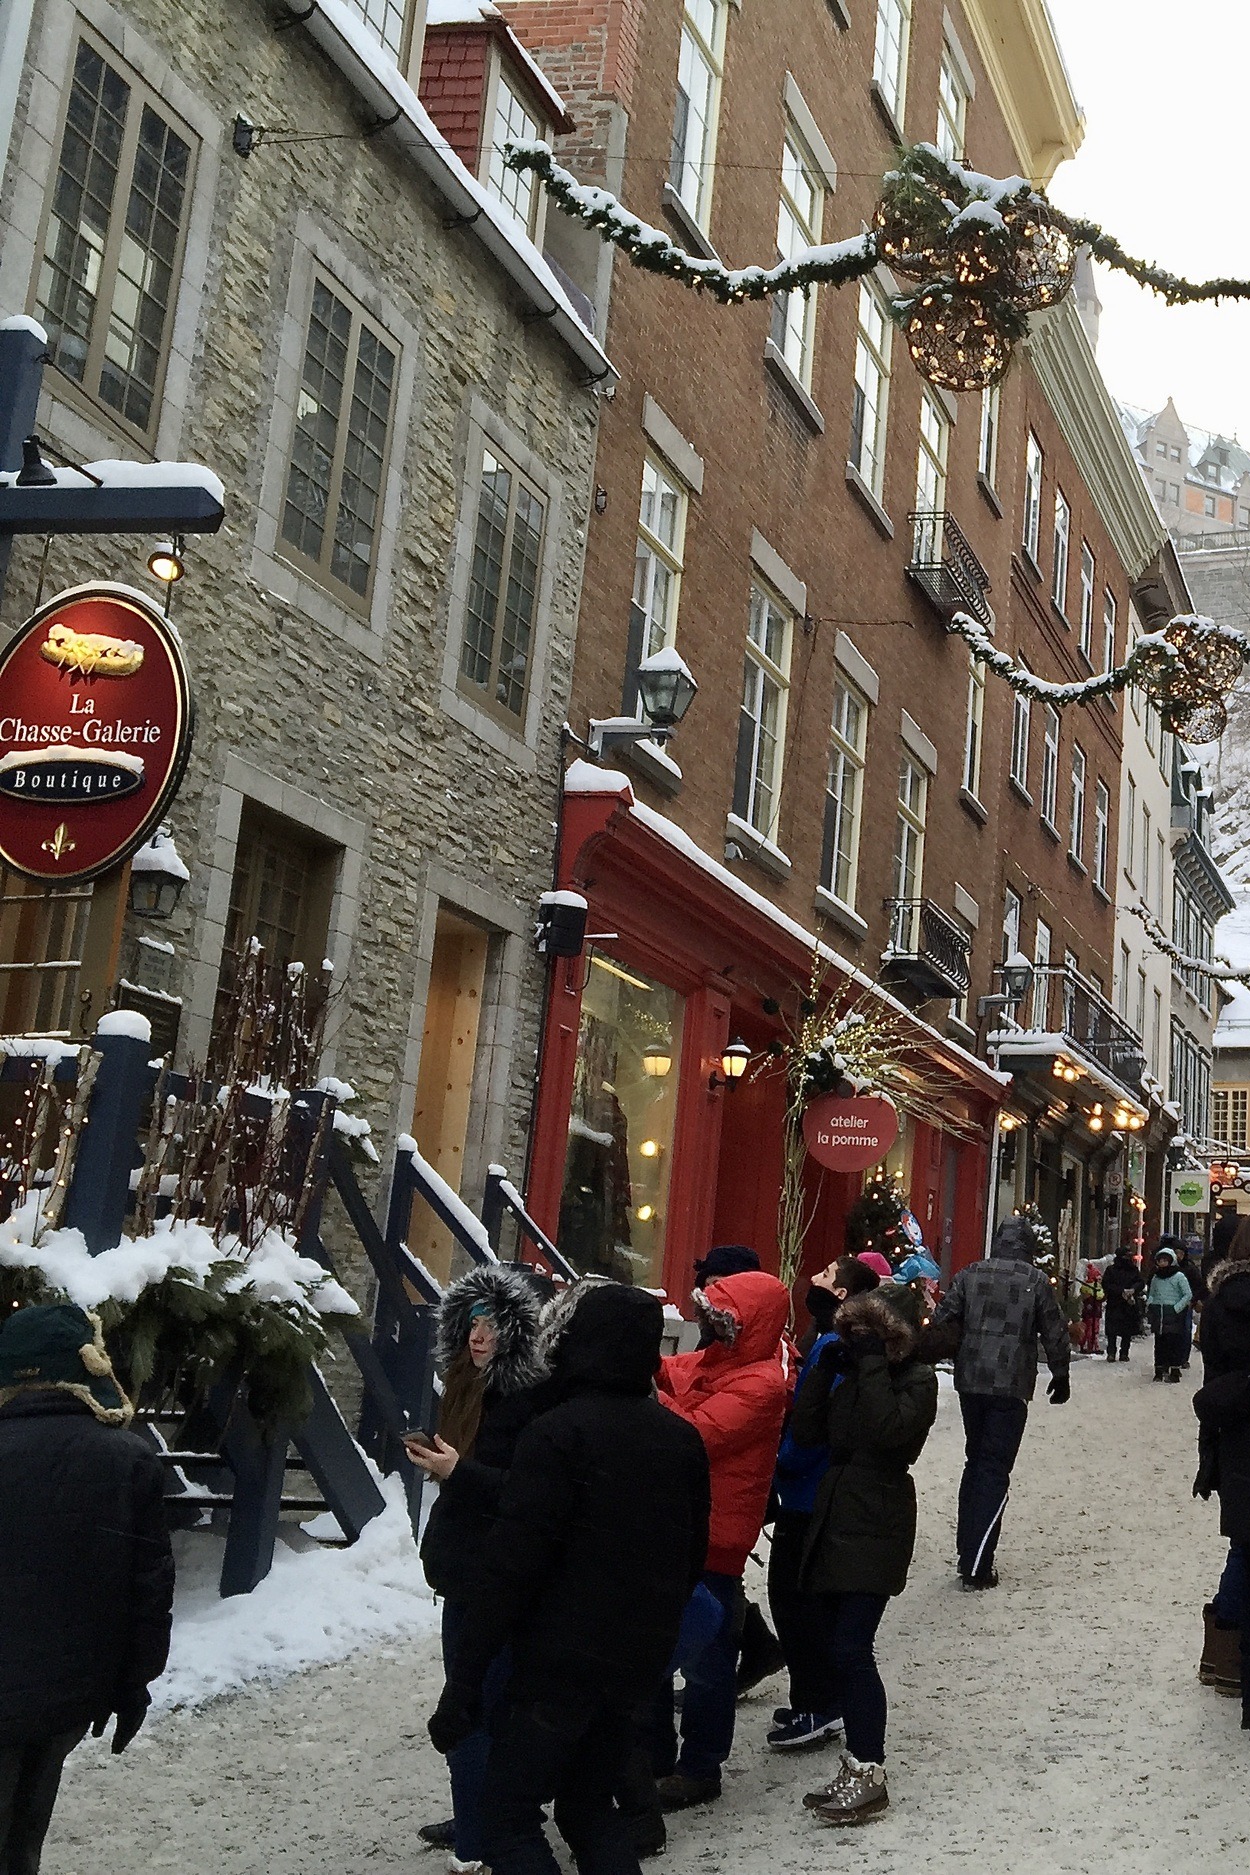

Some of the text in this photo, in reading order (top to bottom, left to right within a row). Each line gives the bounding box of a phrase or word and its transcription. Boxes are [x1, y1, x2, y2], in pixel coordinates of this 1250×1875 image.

[70, 693, 95, 714] La
[0, 717, 161, 743] Chasse-Galerie
[14, 770, 121, 793] Boutique
[830, 1115, 868, 1128] atelier
[817, 1131, 878, 1147] la pomme
